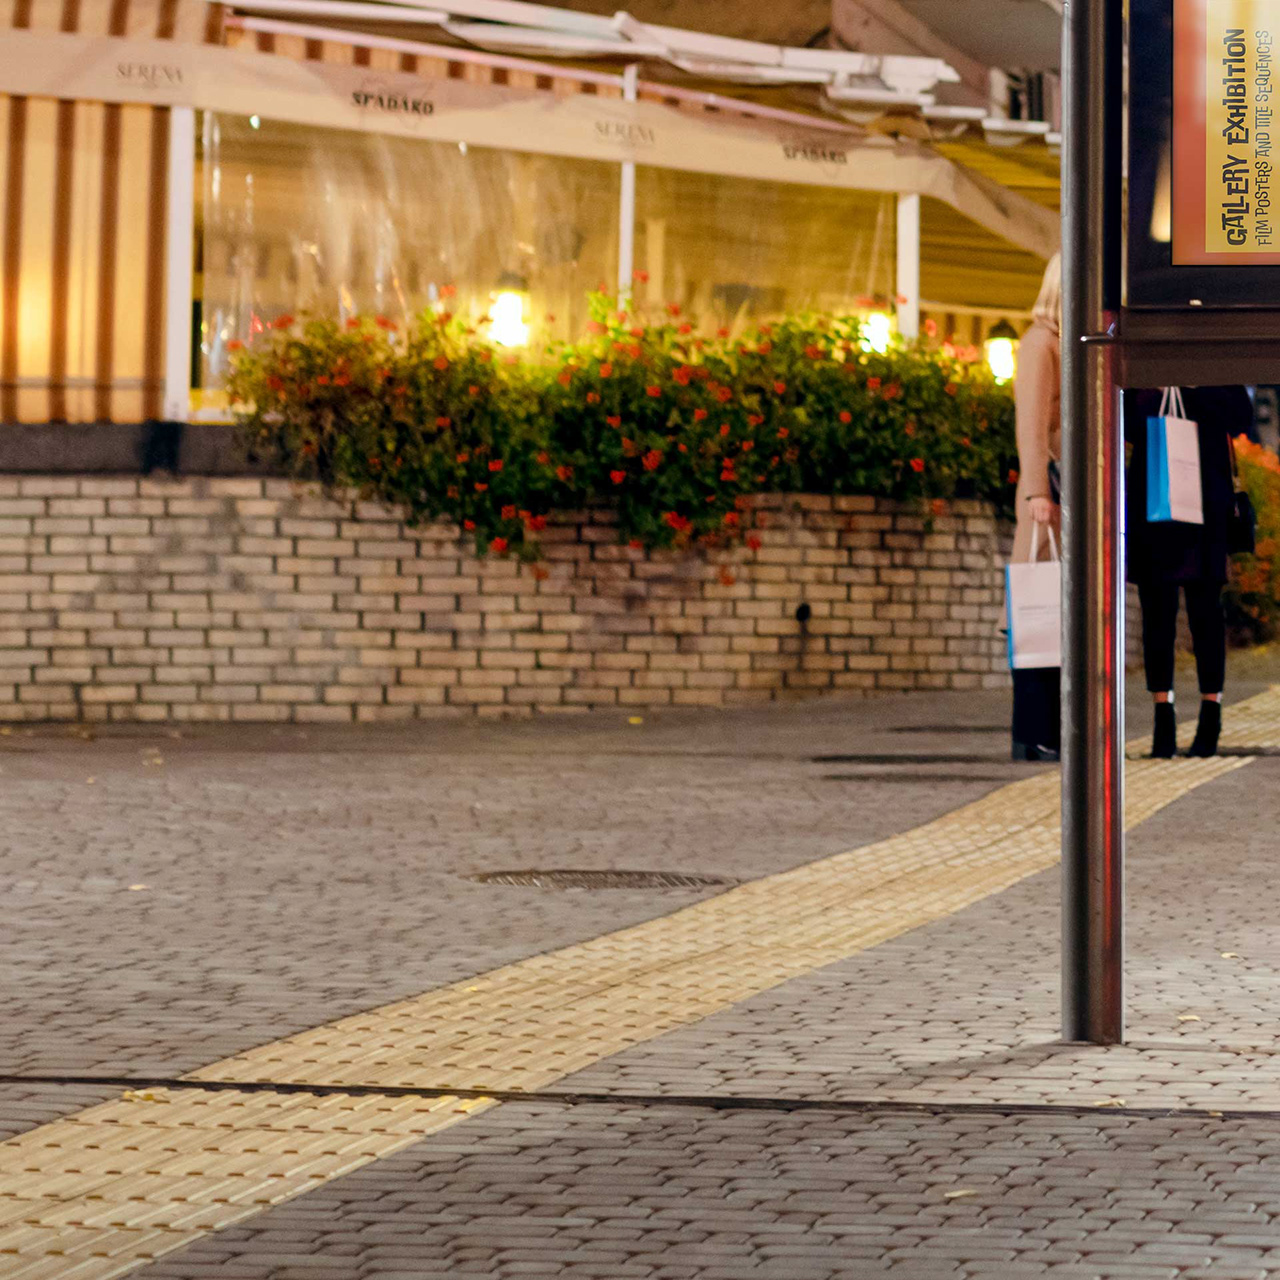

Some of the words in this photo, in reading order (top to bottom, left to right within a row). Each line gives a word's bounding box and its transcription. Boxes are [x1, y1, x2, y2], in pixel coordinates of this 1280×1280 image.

[1222, 29, 1249, 146] EXHIBITION
[1255, 30, 1273, 102] SEQUENCES
[1255, 106, 1273, 130] TITLE
[1255, 134, 1270, 157] AND
[1222, 154, 1250, 246] GALLERY
[1255, 161, 1272, 217] POSTERS
[1255, 219, 1273, 246] FILM
